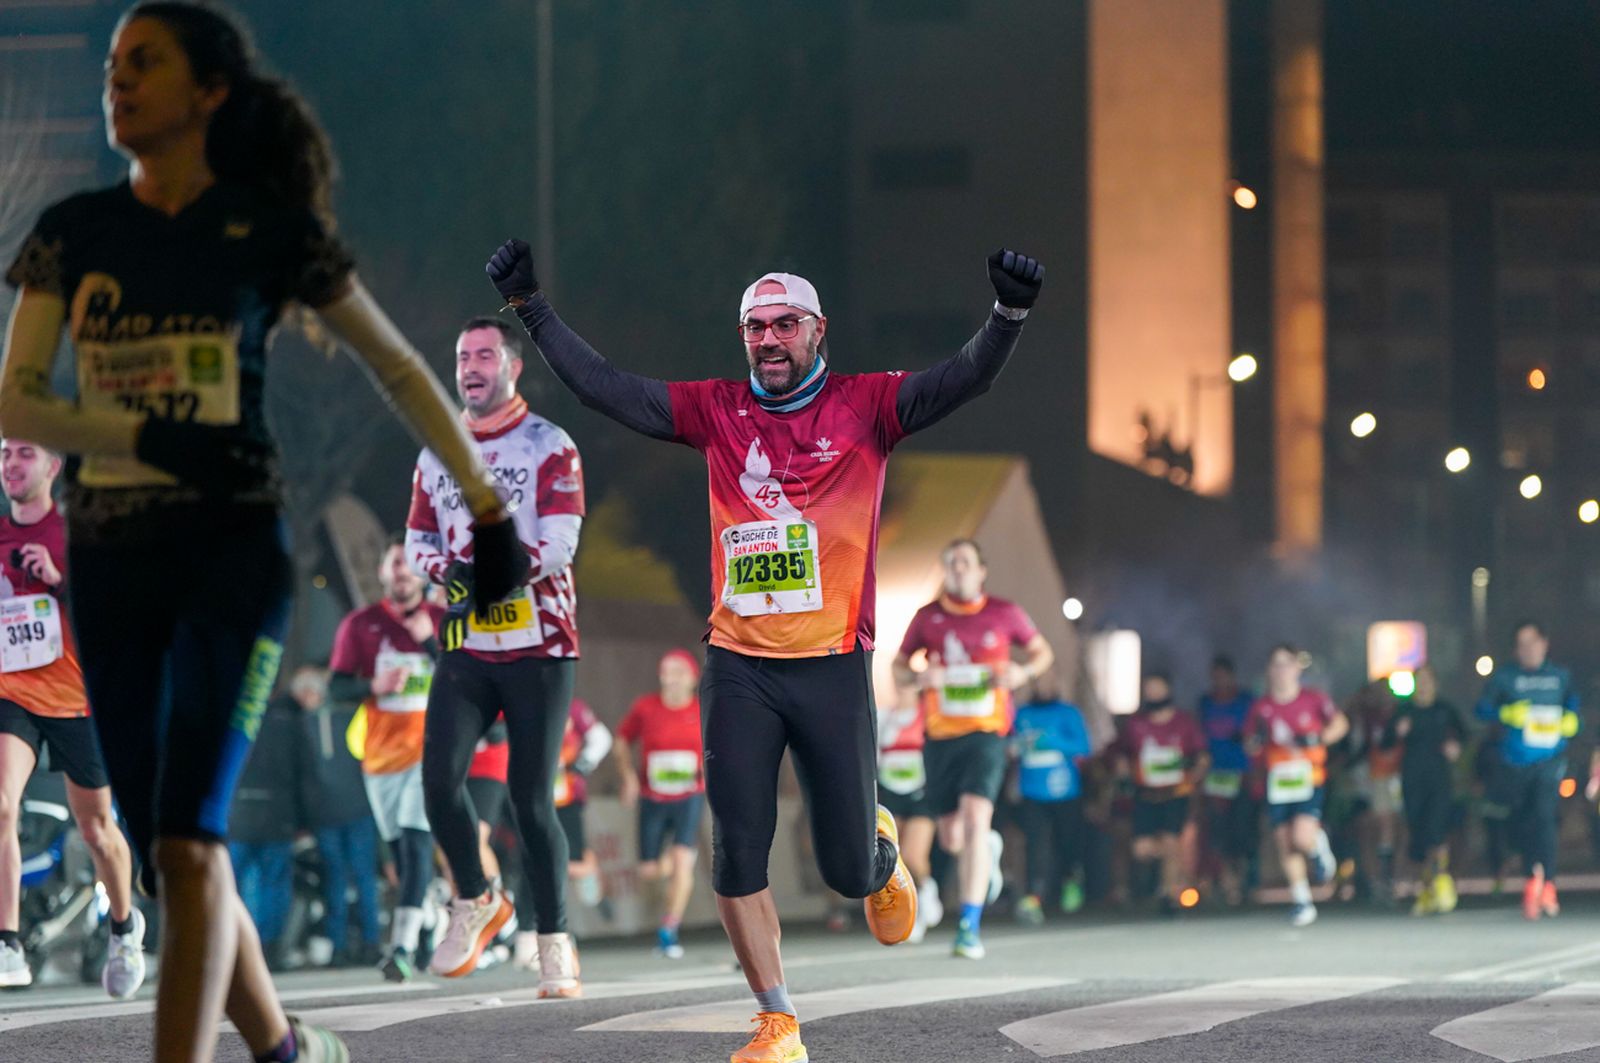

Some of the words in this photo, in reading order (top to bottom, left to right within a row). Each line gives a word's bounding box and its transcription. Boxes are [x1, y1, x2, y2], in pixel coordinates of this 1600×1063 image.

[754, 485, 781, 509] 43
[741, 531, 766, 543] NOCHE
[767, 531, 779, 540] DE
[733, 545, 746, 556] SAN
[734, 552, 806, 584] 12335
